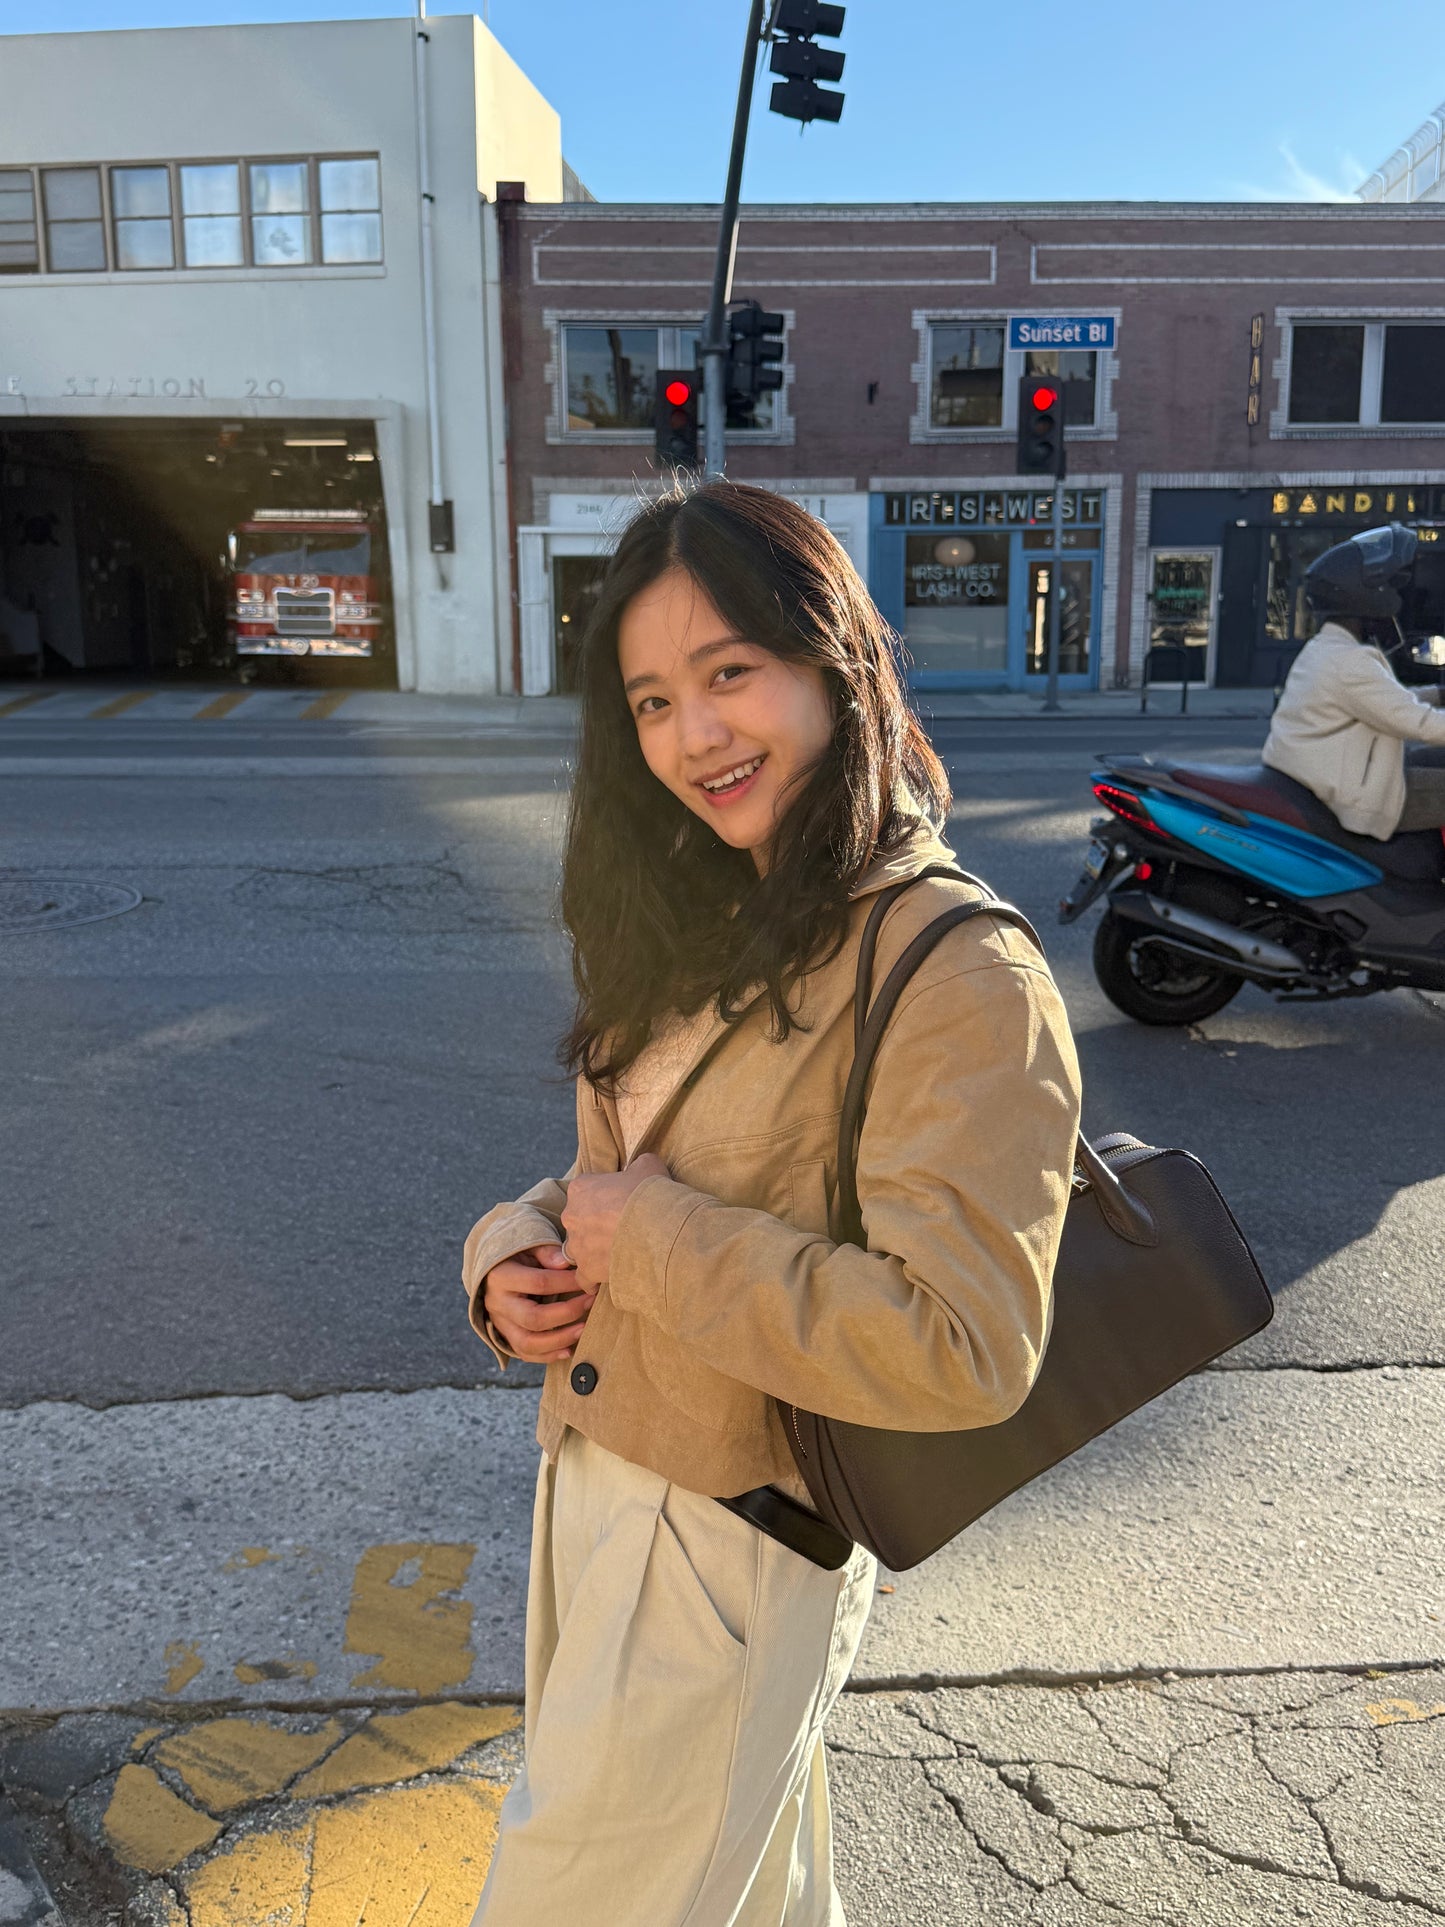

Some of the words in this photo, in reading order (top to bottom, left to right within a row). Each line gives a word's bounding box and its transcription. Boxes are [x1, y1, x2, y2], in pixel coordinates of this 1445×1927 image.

[1018, 323, 1081, 343] Sunset
[1089, 323, 1107, 342] Bl
[1247, 315, 1264, 425] BAR
[65, 377, 207, 397] STATION
[244, 379, 286, 398] 20
[892, 497, 1099, 520] IRIS+WEST
[1272, 493, 1416, 513] BANDI
[301, 574, 319, 588] 20
[911, 563, 1001, 581] IRIS+WEST
[916, 582, 962, 598] LASH
